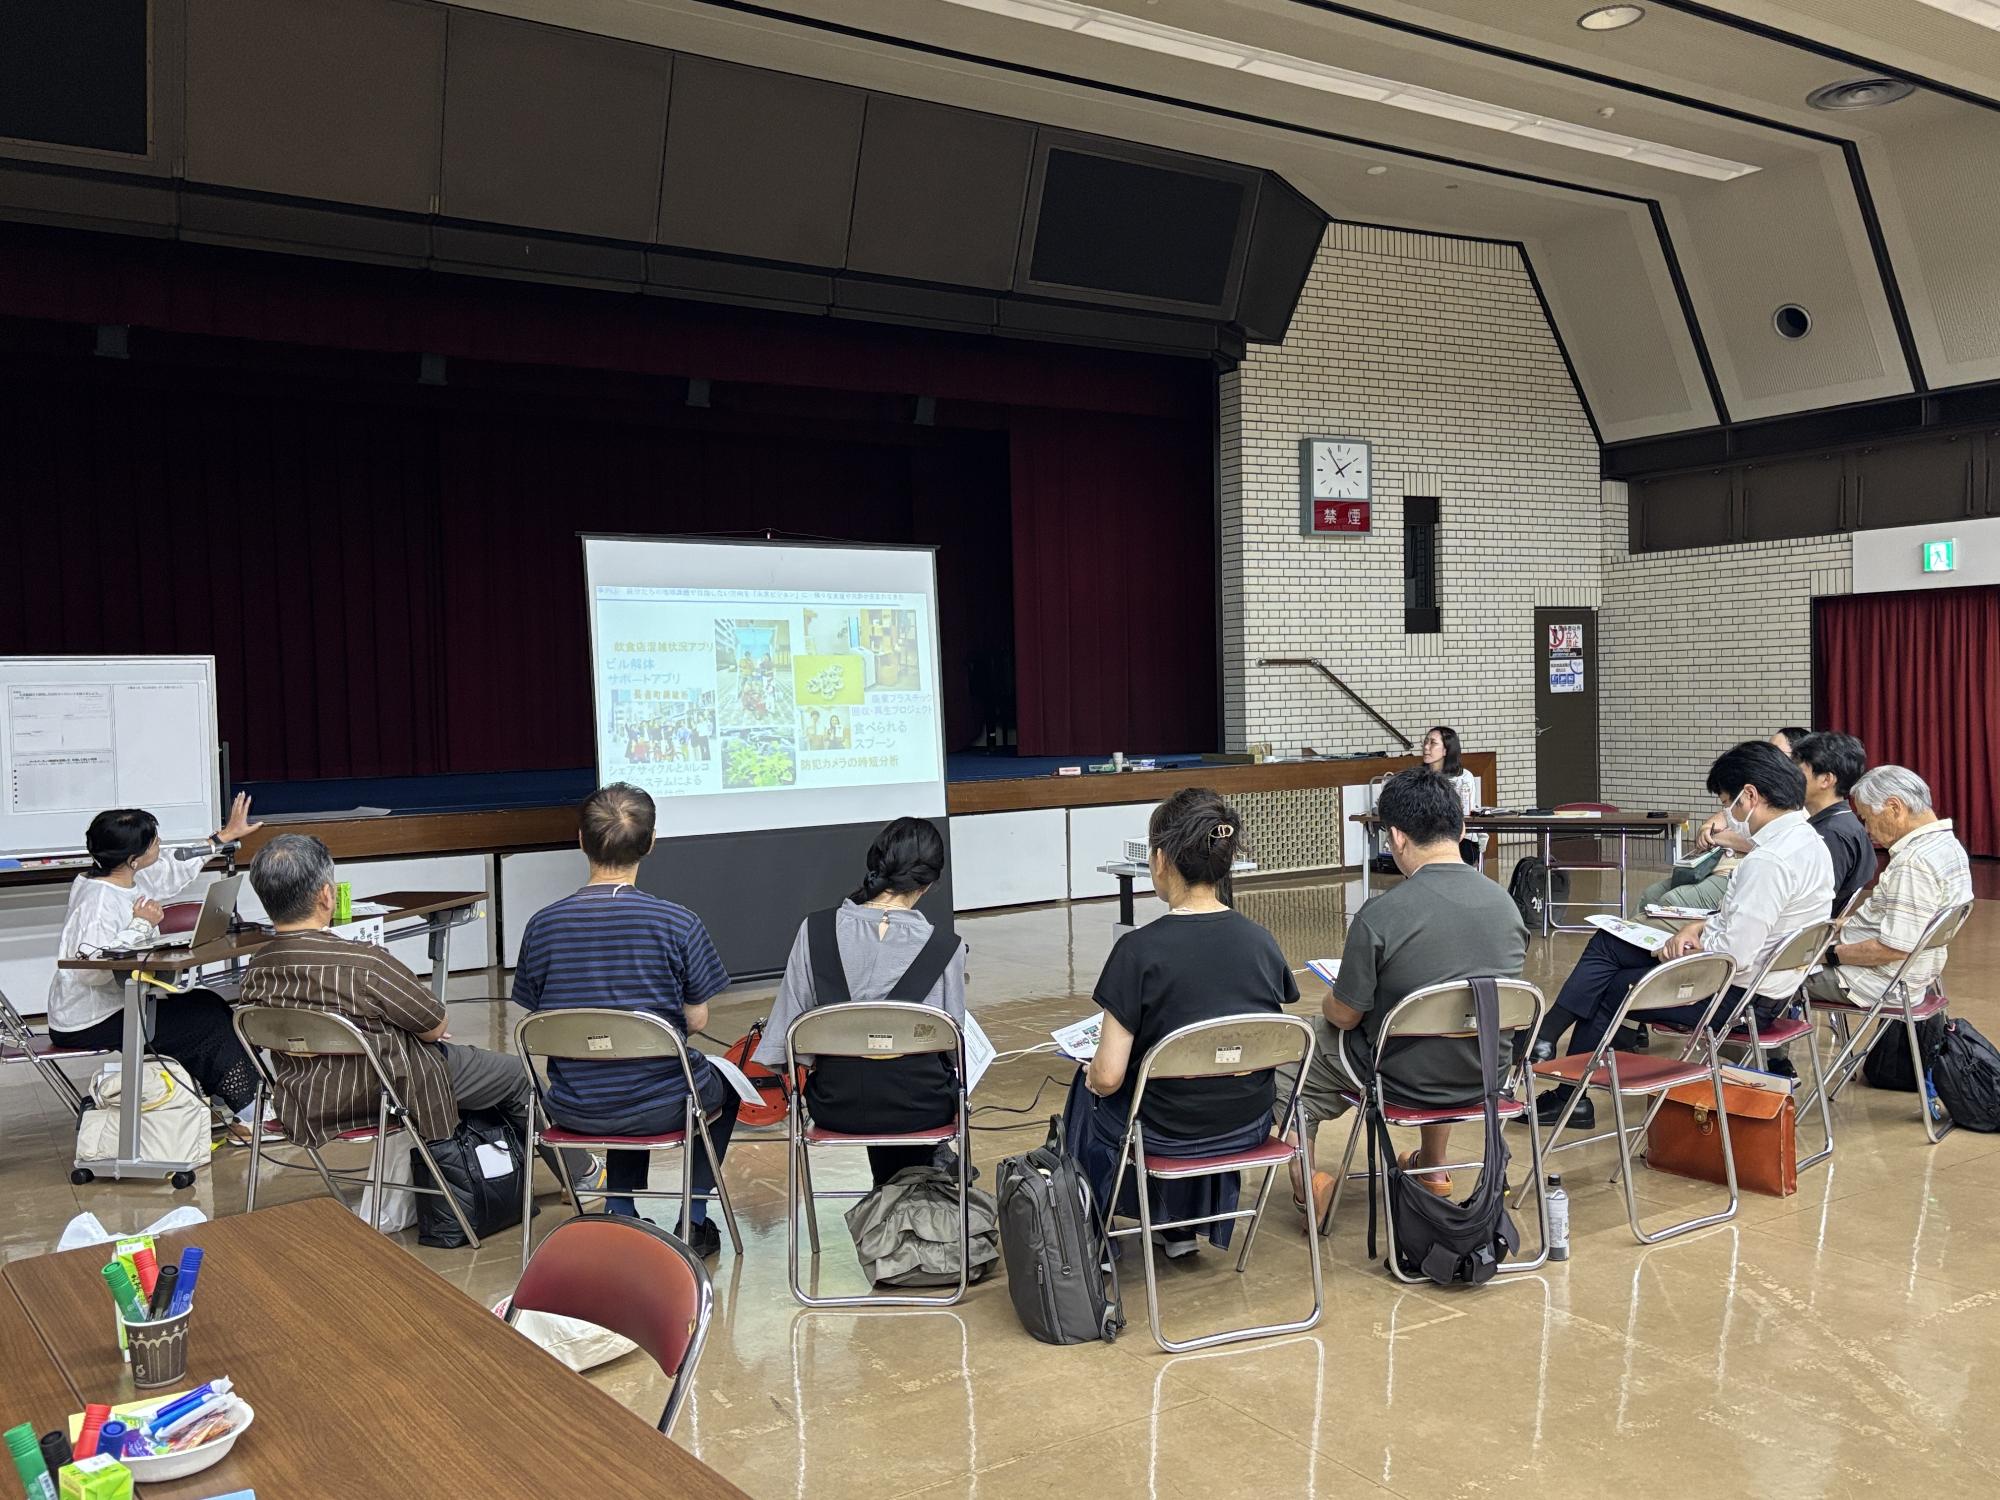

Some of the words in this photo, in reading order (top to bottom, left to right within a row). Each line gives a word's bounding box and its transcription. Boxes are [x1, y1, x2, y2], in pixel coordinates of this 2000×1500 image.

[1324, 508, 1361, 525] 禁煙
[613, 641, 714, 653] 飲食店混雑状況アプリ
[606, 657, 655, 670] ビル解体
[607, 673, 680, 685] サポートアプリ
[853, 719, 908, 735] 食べられる
[854, 737, 897, 750] スプーン
